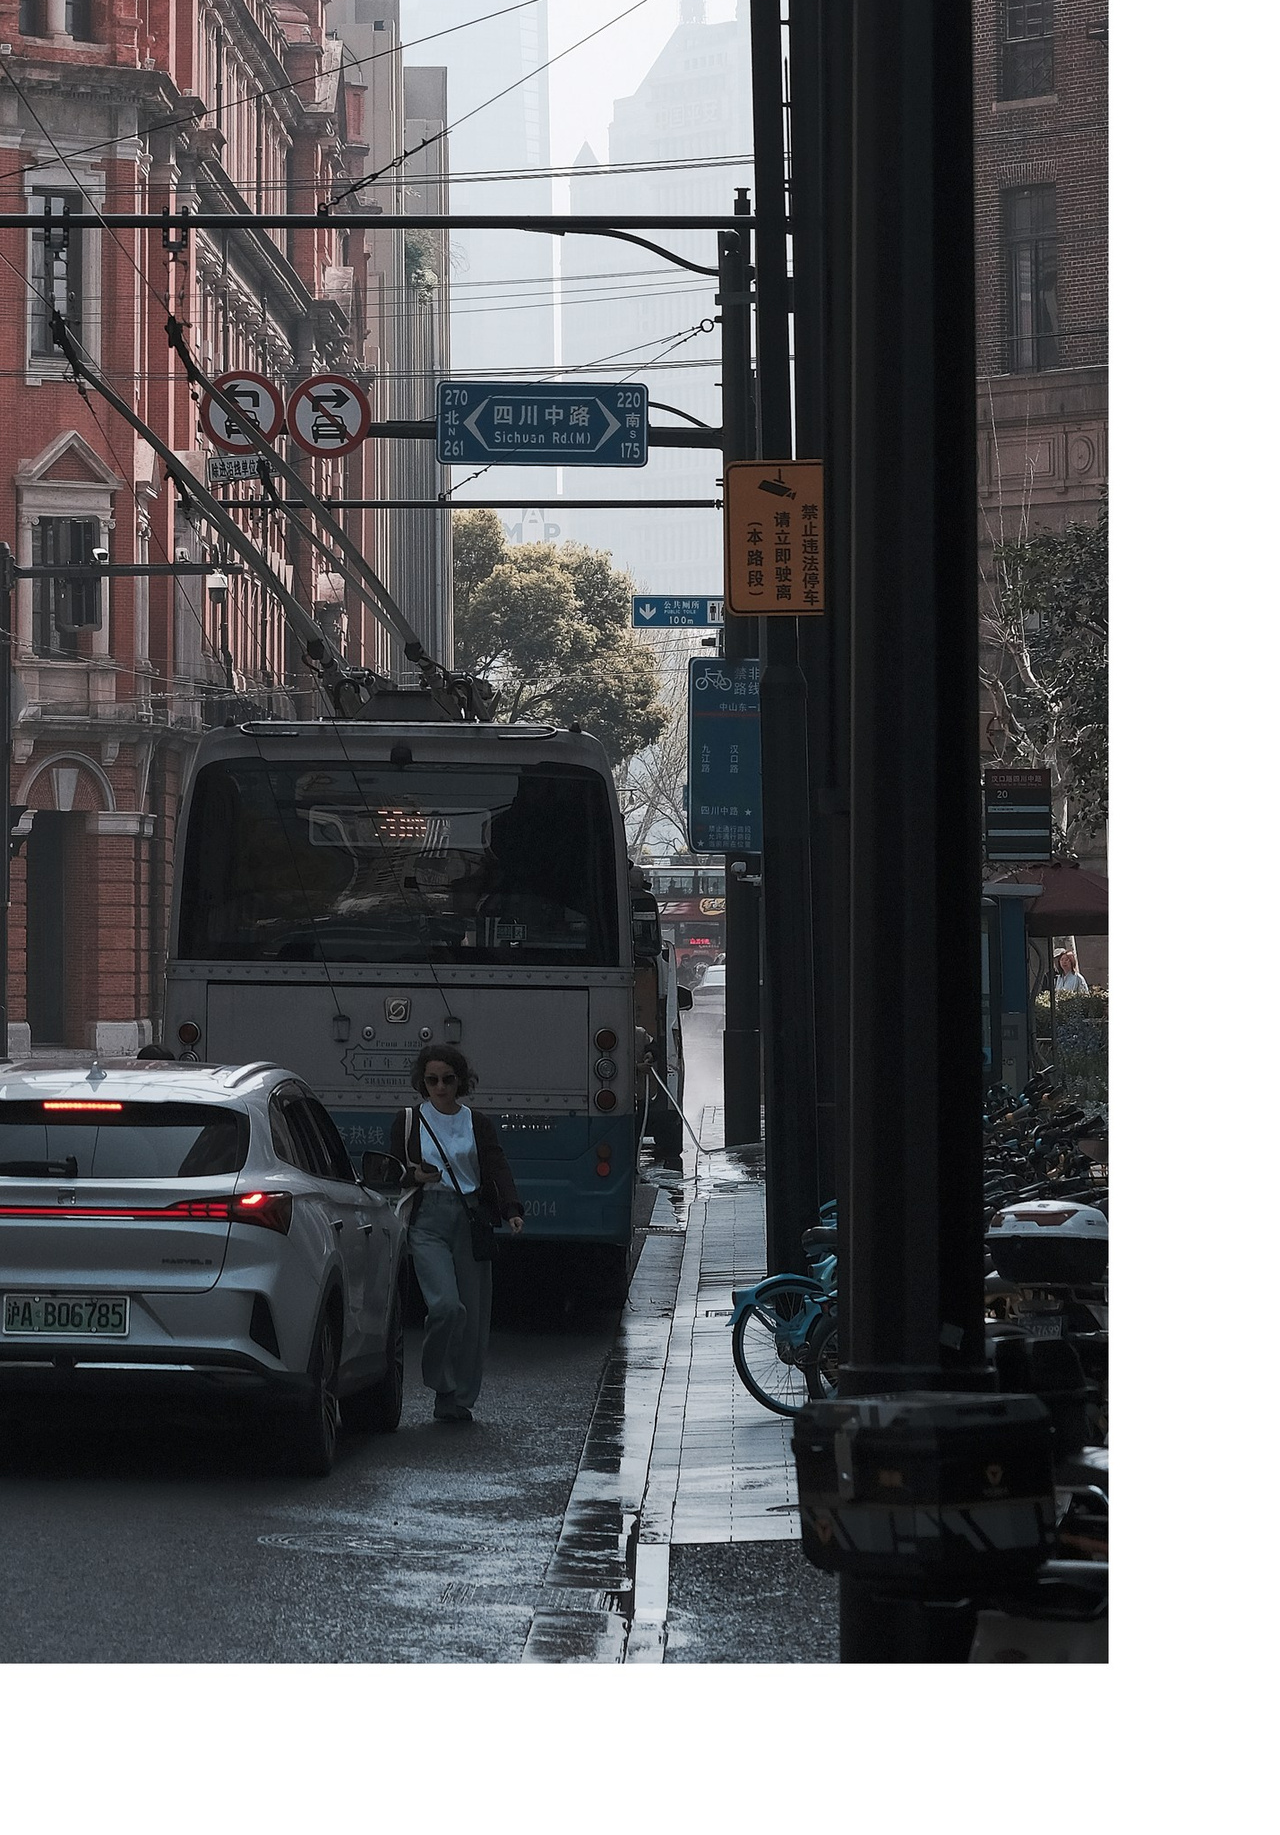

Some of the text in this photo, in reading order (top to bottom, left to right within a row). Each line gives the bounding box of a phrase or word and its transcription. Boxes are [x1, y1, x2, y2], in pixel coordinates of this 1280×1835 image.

[445, 389, 468, 406] 270
[617, 392, 641, 408] 220
[444, 410, 460, 426] 北
[494, 405, 590, 427] 四川中路
[625, 412, 640, 428] 南
[448, 428, 456, 437] N
[494, 430, 591, 445] Sichuan Rd.(M)
[629, 430, 637, 439] S
[444, 440, 464, 456] 261
[621, 443, 641, 459] 175
[774, 511, 792, 601] 请立即驶离
[801, 504, 820, 606] 禁止违法停车
[663, 600, 699, 610] 公共厕所
[719, 703, 761, 712] 中山东一
[701, 744, 711, 773] 九江路
[729, 744, 739, 773] 汉口路
[996, 790, 1008, 799] 20
[701, 806, 738, 816] 四川中路
